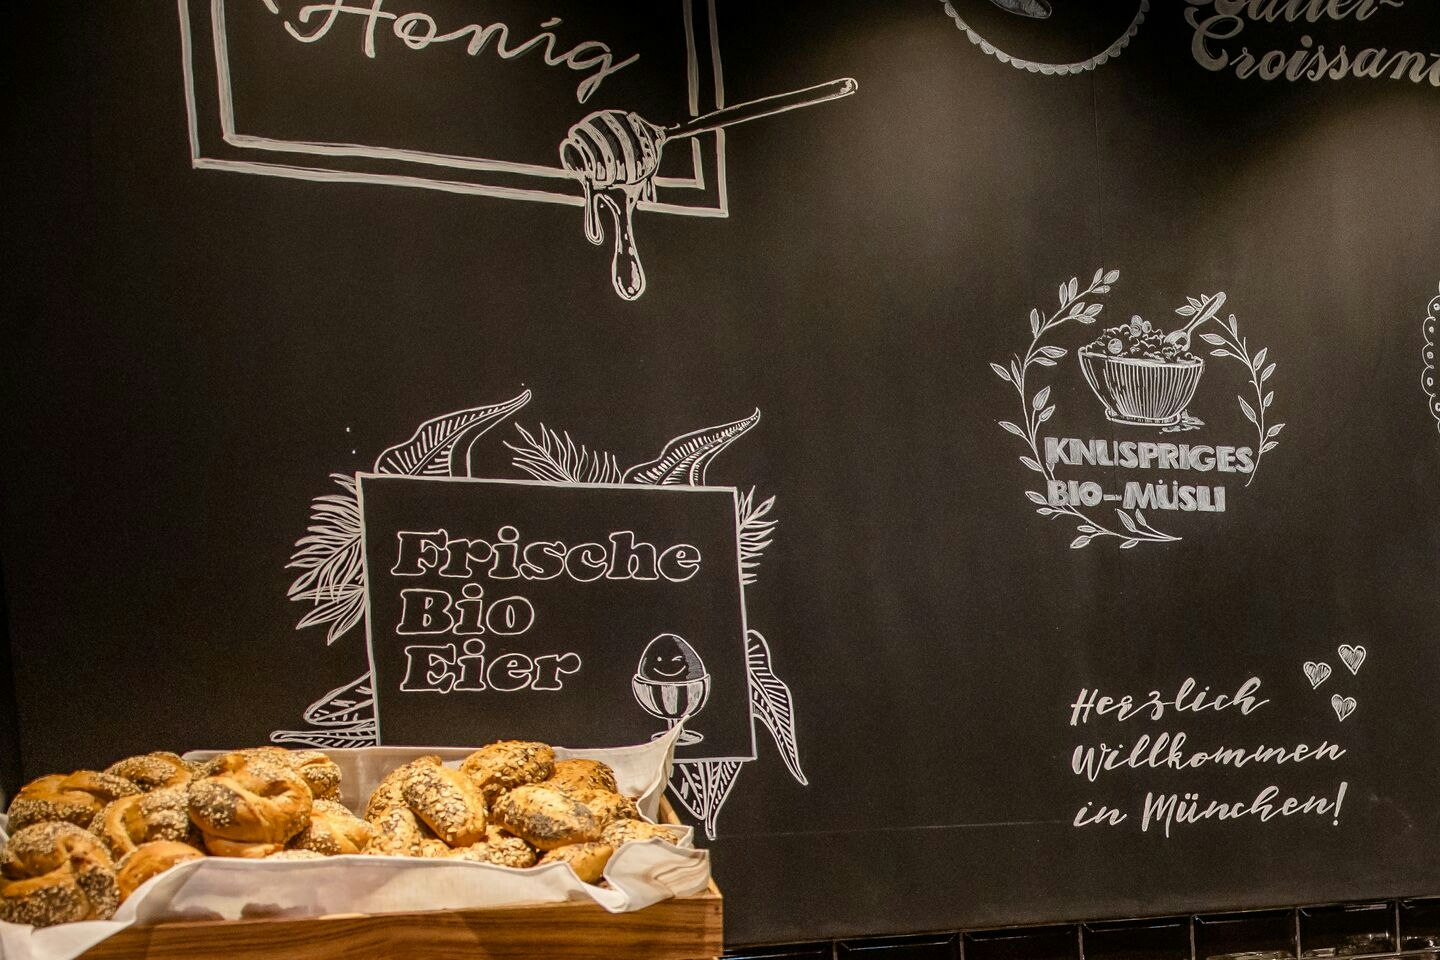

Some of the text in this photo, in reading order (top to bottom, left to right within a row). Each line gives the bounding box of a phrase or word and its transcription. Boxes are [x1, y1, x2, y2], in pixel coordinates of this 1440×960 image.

[1044, 436, 1255, 474] KNUSPRIGES
[1047, 478, 1226, 512] BIO-MÜSLI
[391, 525, 702, 582] Frische
[396, 583, 535, 636] Bio
[400, 638, 582, 692] Eier
[1069, 677, 1270, 726] Herzlich
[1071, 732, 1347, 782] Willkommen
[1073, 781, 1348, 838] in München!
